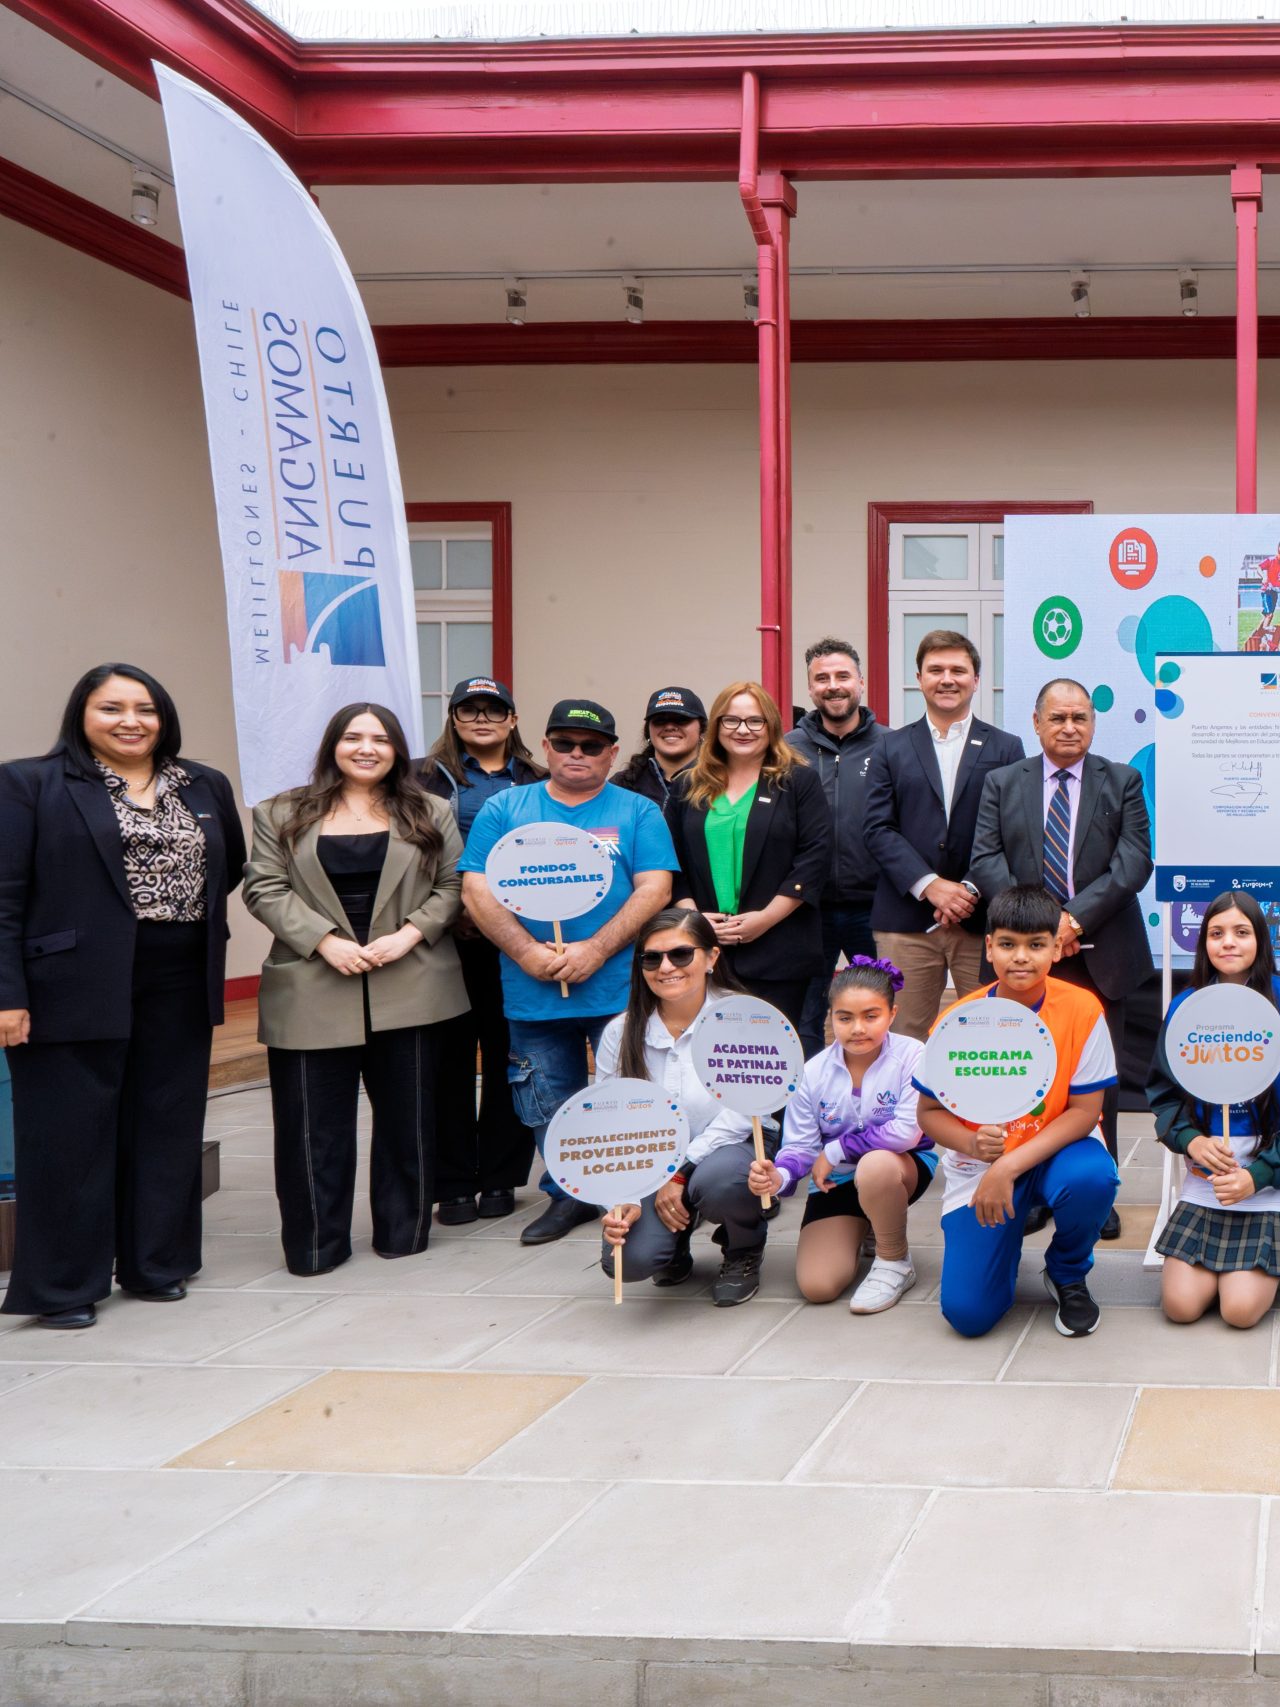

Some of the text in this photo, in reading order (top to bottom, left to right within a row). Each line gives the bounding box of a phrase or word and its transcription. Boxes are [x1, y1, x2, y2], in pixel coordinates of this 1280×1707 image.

[520, 863, 577, 874] FONDOS
[498, 873, 604, 888] CONCURSABLES
[1196, 1024, 1235, 1032] Programa
[1187, 1031, 1263, 1043] Creciendo
[713, 1043, 779, 1056] ACADEMIA
[948, 1050, 1033, 1061] PROGRAMA
[1186, 1043, 1265, 1065] Juntos
[708, 1058, 788, 1071] DE PATINAJE
[715, 1071, 783, 1085] ARTÍSTICO
[954, 1066, 1027, 1077] ESCUELAS
[560, 1128, 677, 1147] FORTALECIMIENTO
[560, 1141, 676, 1162] PROVEEDORES
[583, 1158, 654, 1176] LOCALES
